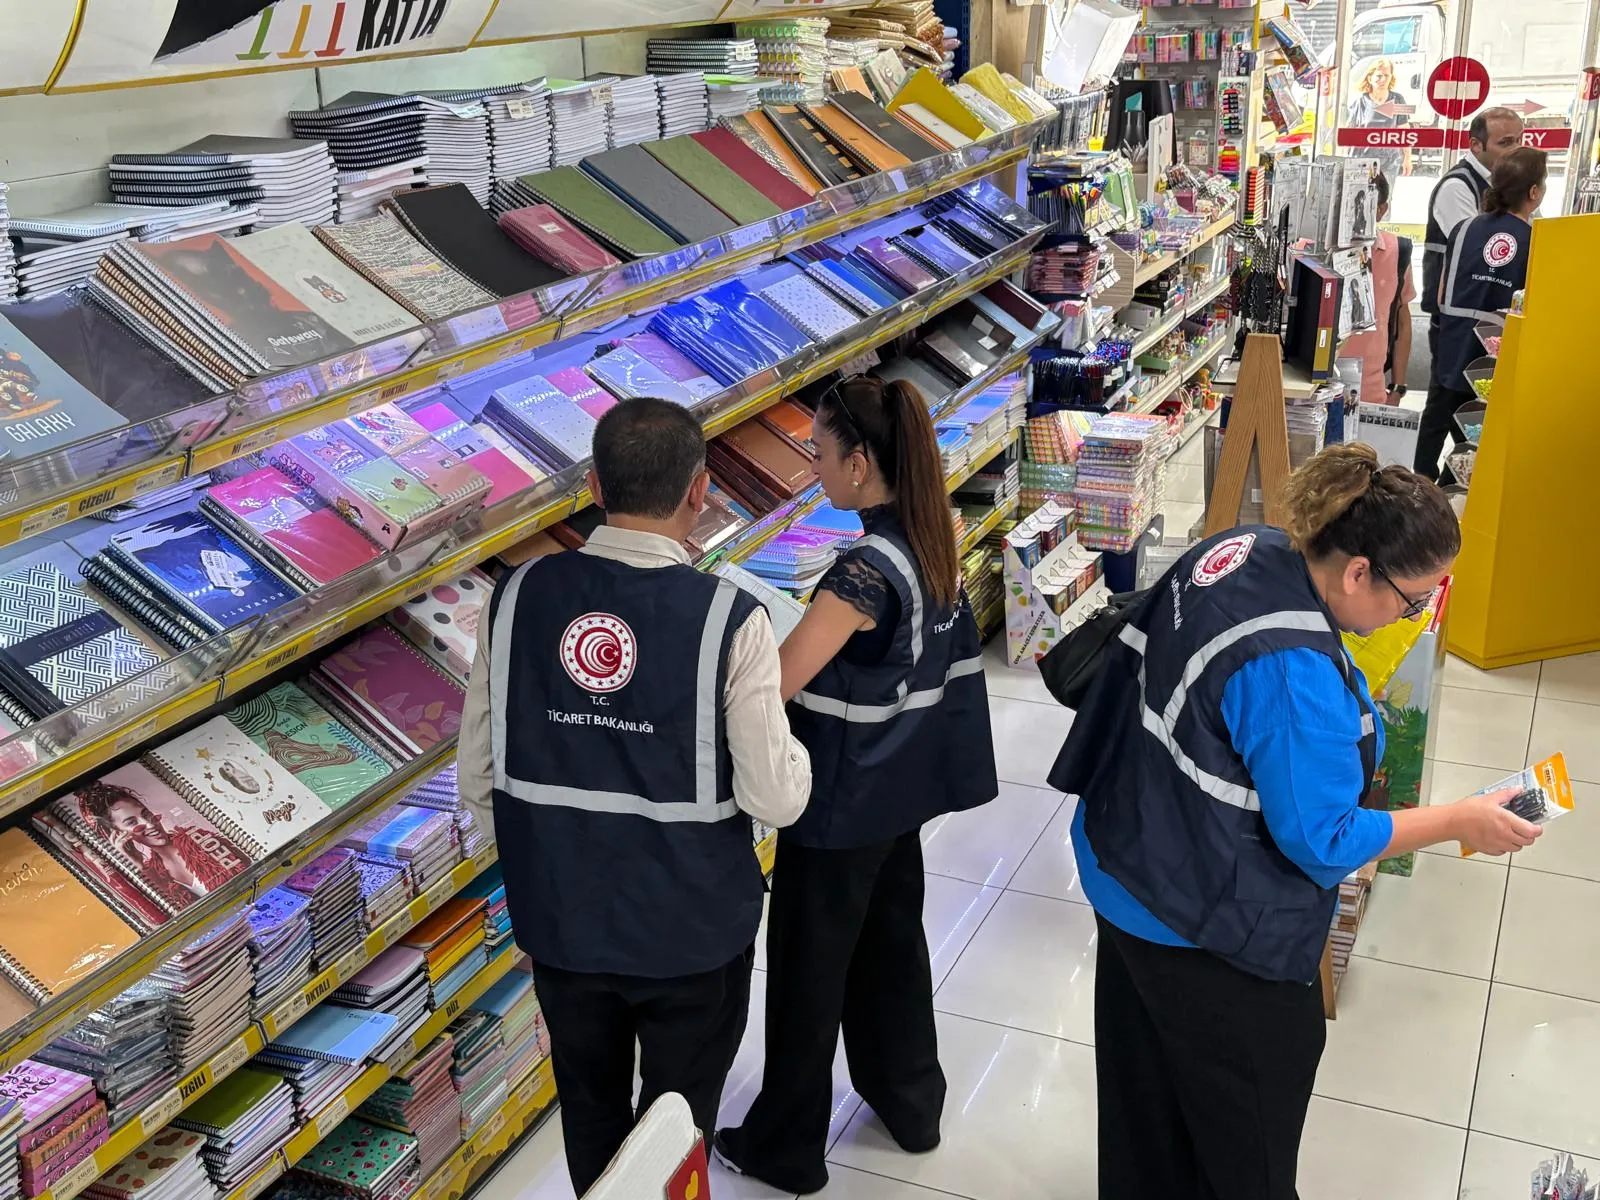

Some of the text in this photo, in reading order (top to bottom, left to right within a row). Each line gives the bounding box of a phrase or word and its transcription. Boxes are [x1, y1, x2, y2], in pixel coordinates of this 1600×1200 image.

[1366, 130, 1547, 147] GİRİŞ RY
[4, 411, 76, 443] GALAXY
[589, 694, 610, 706] T.C.
[546, 709, 655, 734] TİCARET BAKANLIĞI
[305, 978, 331, 1006] OKTALI
[180, 1071, 207, 1100] İZGİLİ
